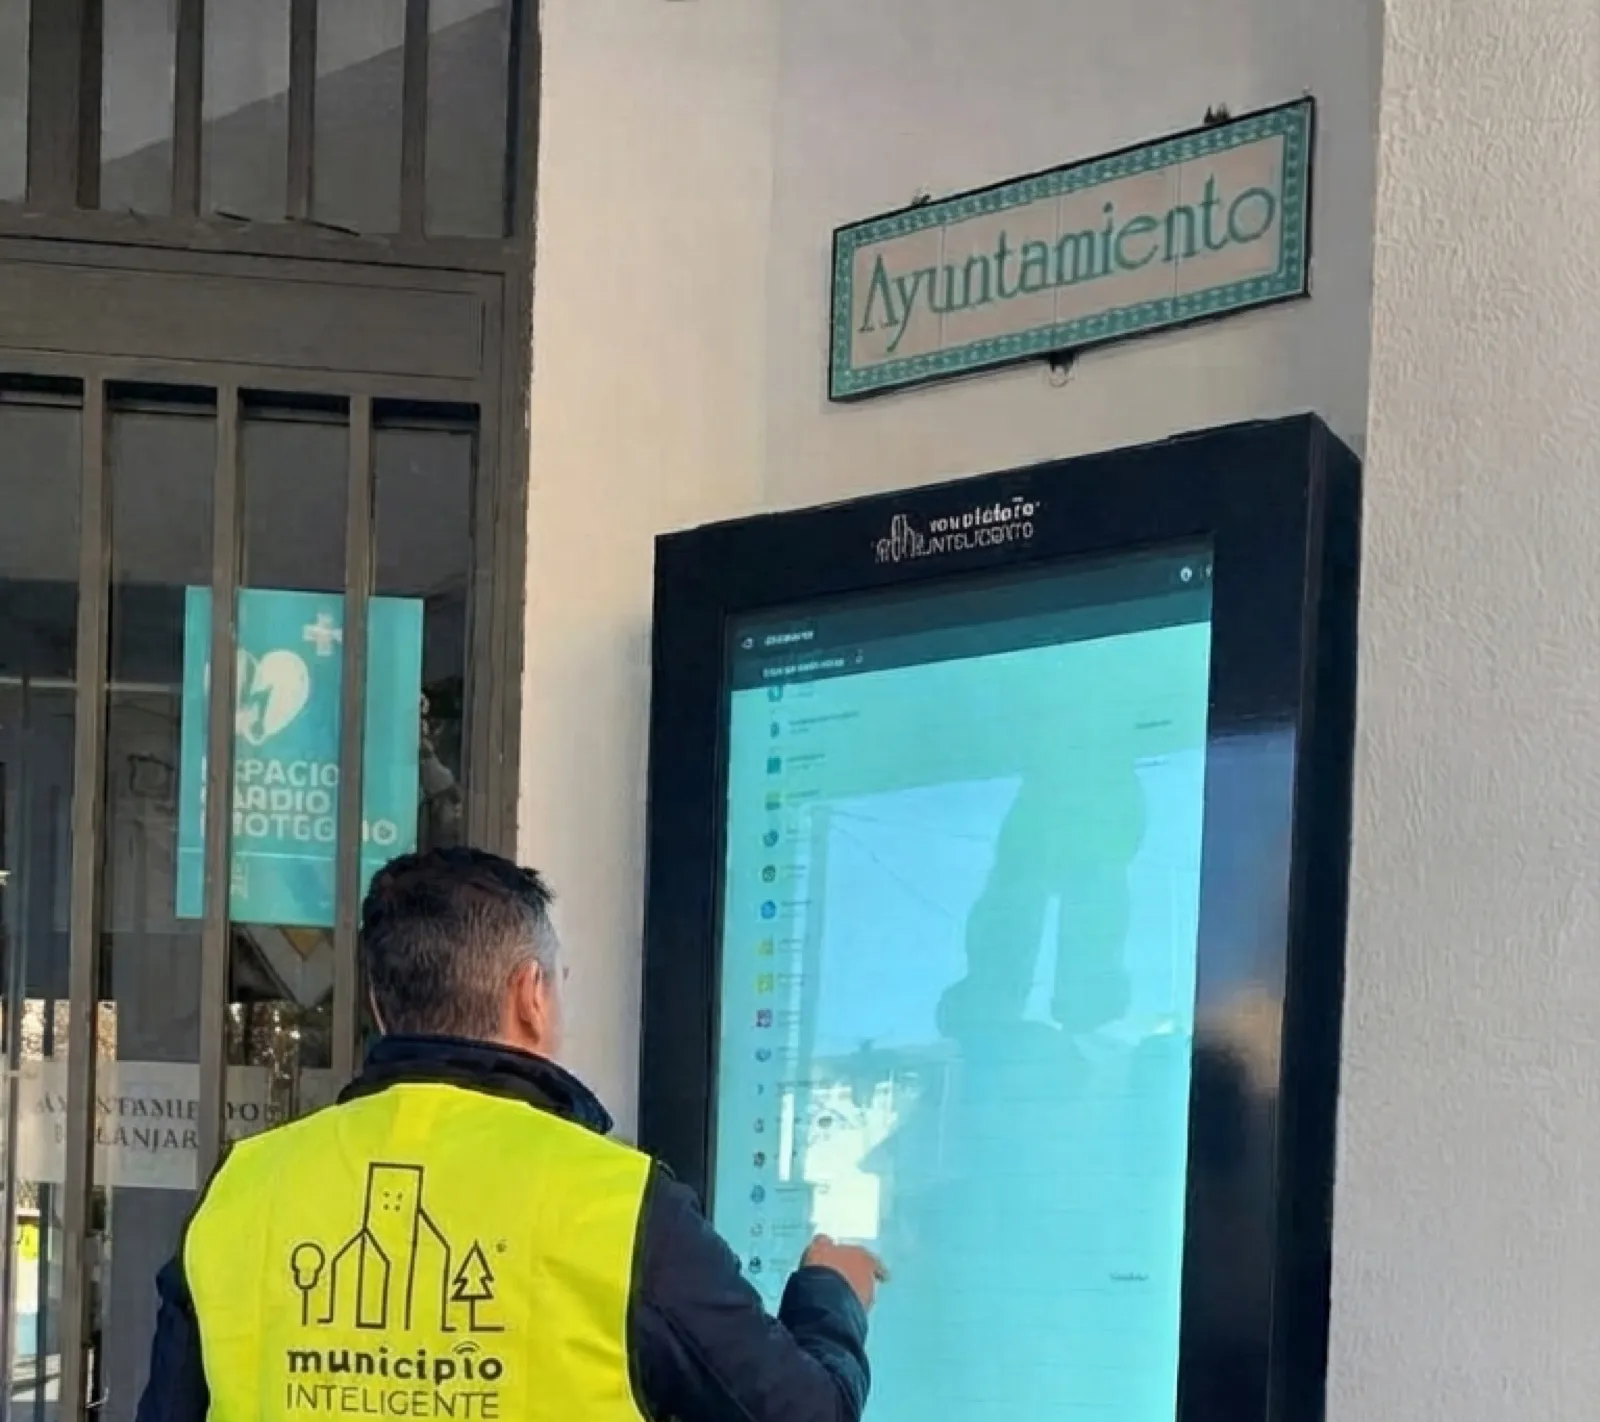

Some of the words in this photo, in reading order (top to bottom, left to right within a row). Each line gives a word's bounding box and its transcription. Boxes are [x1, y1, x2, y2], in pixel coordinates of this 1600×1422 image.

[857, 172, 1275, 352] Ayuntamiento
[286, 1346, 503, 1385] municipio
[286, 1382, 499, 1419] INTELIGENTE
